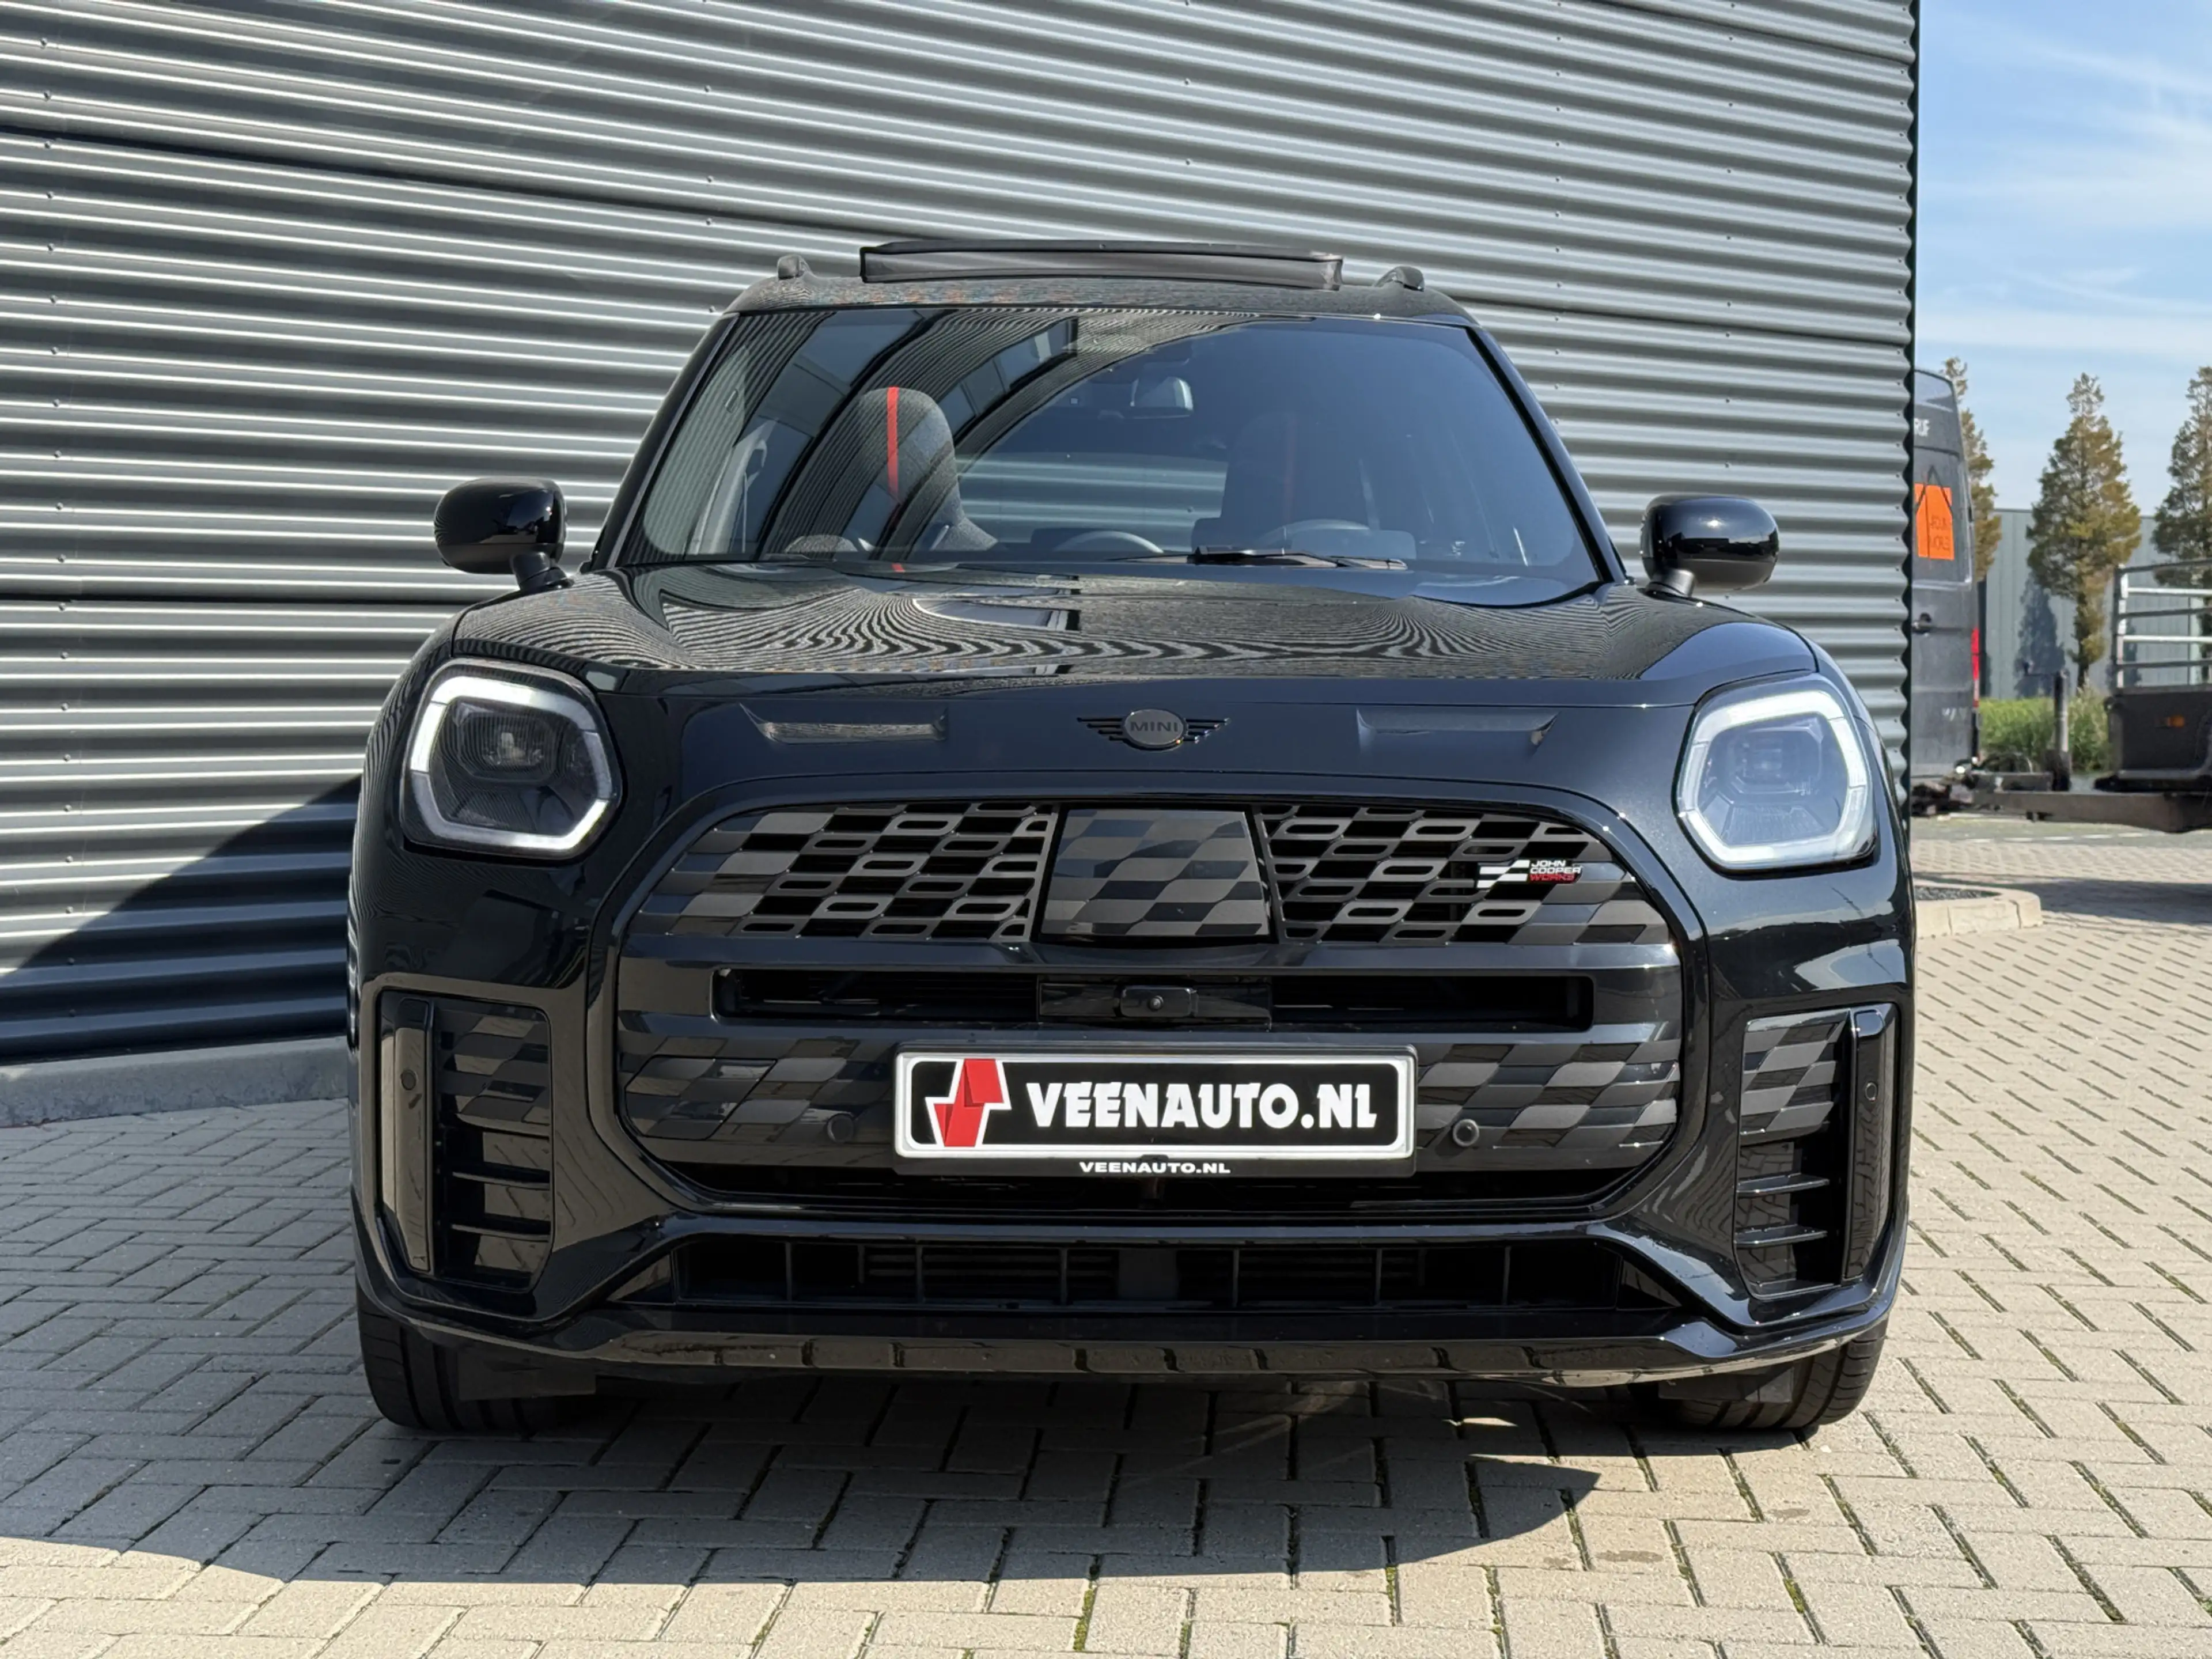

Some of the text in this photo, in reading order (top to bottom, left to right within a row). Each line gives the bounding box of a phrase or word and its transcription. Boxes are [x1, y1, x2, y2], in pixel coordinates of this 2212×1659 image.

[1130, 721, 1179, 732] MINI
[1026, 1081, 1377, 1130] VEENAUTO.NL
[1078, 1161, 1231, 1173] VEENAUTO.NL
